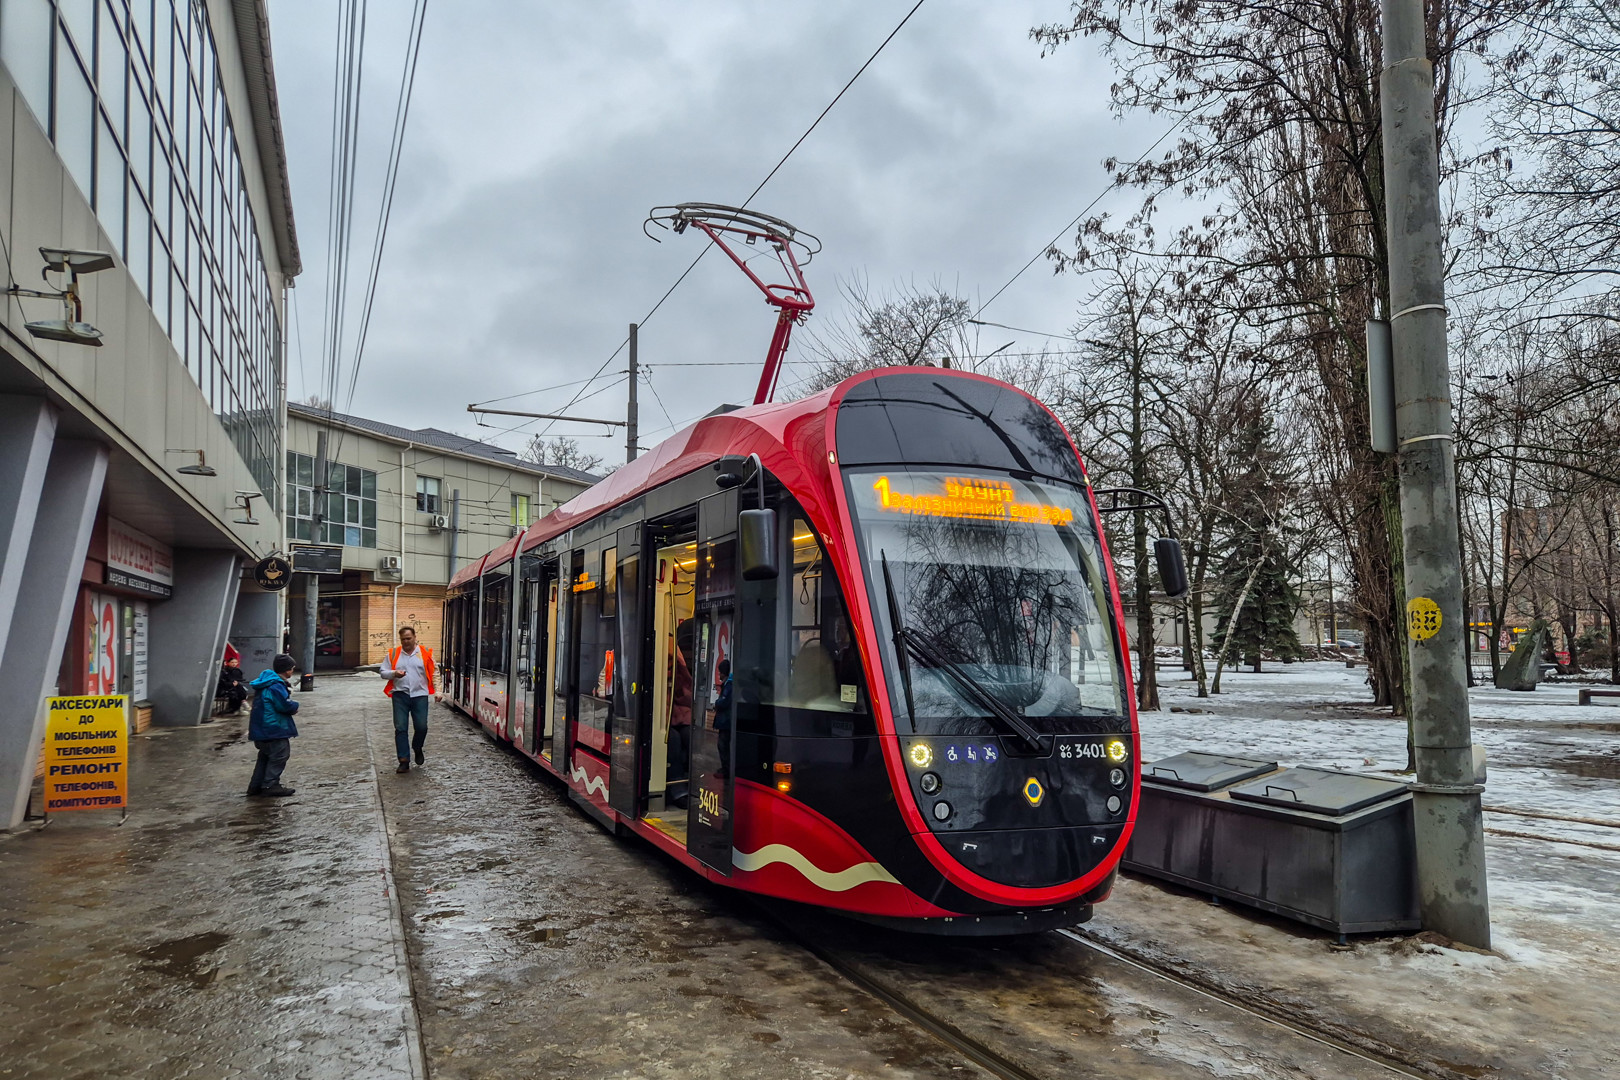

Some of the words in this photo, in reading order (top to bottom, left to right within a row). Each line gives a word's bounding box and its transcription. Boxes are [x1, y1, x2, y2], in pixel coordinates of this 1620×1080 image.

[873, 476, 890, 507] 1
[947, 484, 1013, 502] УДУНТ
[1010, 505, 1073, 522] вокзал
[102, 603, 115, 695] 3
[50, 699, 123, 710] АКСЕСУАРИ
[78, 714, 94, 725] ДО
[54, 730, 117, 741] МОБІЛЬНИХ
[55, 745, 116, 756] ТЕЛЕФОНІВ
[1074, 743, 1107, 758] 3401
[49, 762, 122, 776] РЕМОНТ
[54, 781, 117, 793] ТЕЛЕФОНІВ,
[699, 787, 719, 816] 3401
